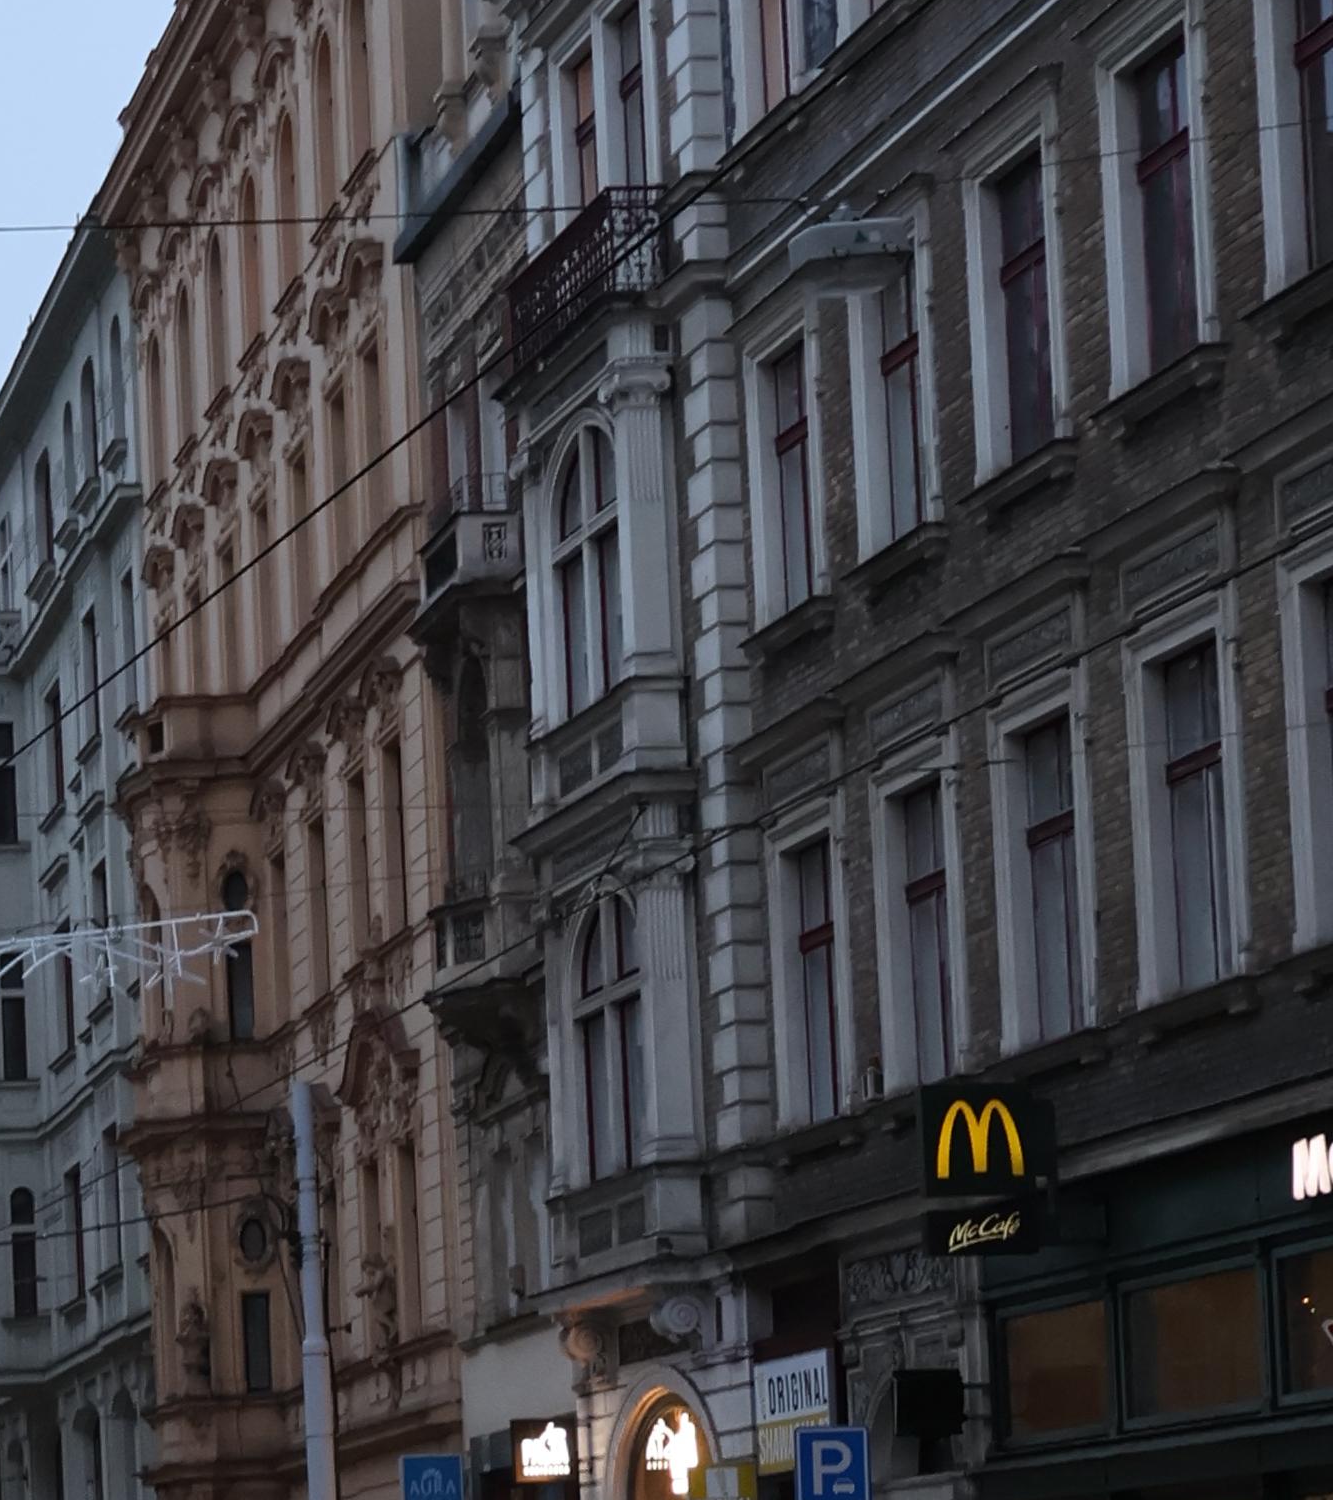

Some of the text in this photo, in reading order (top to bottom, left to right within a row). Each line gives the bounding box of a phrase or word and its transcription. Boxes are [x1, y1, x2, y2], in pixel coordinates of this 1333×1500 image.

[949, 1210, 1021, 1250] McCafé
[768, 1365, 828, 1415] ORIGINAL
[812, 1440, 852, 1495] P
